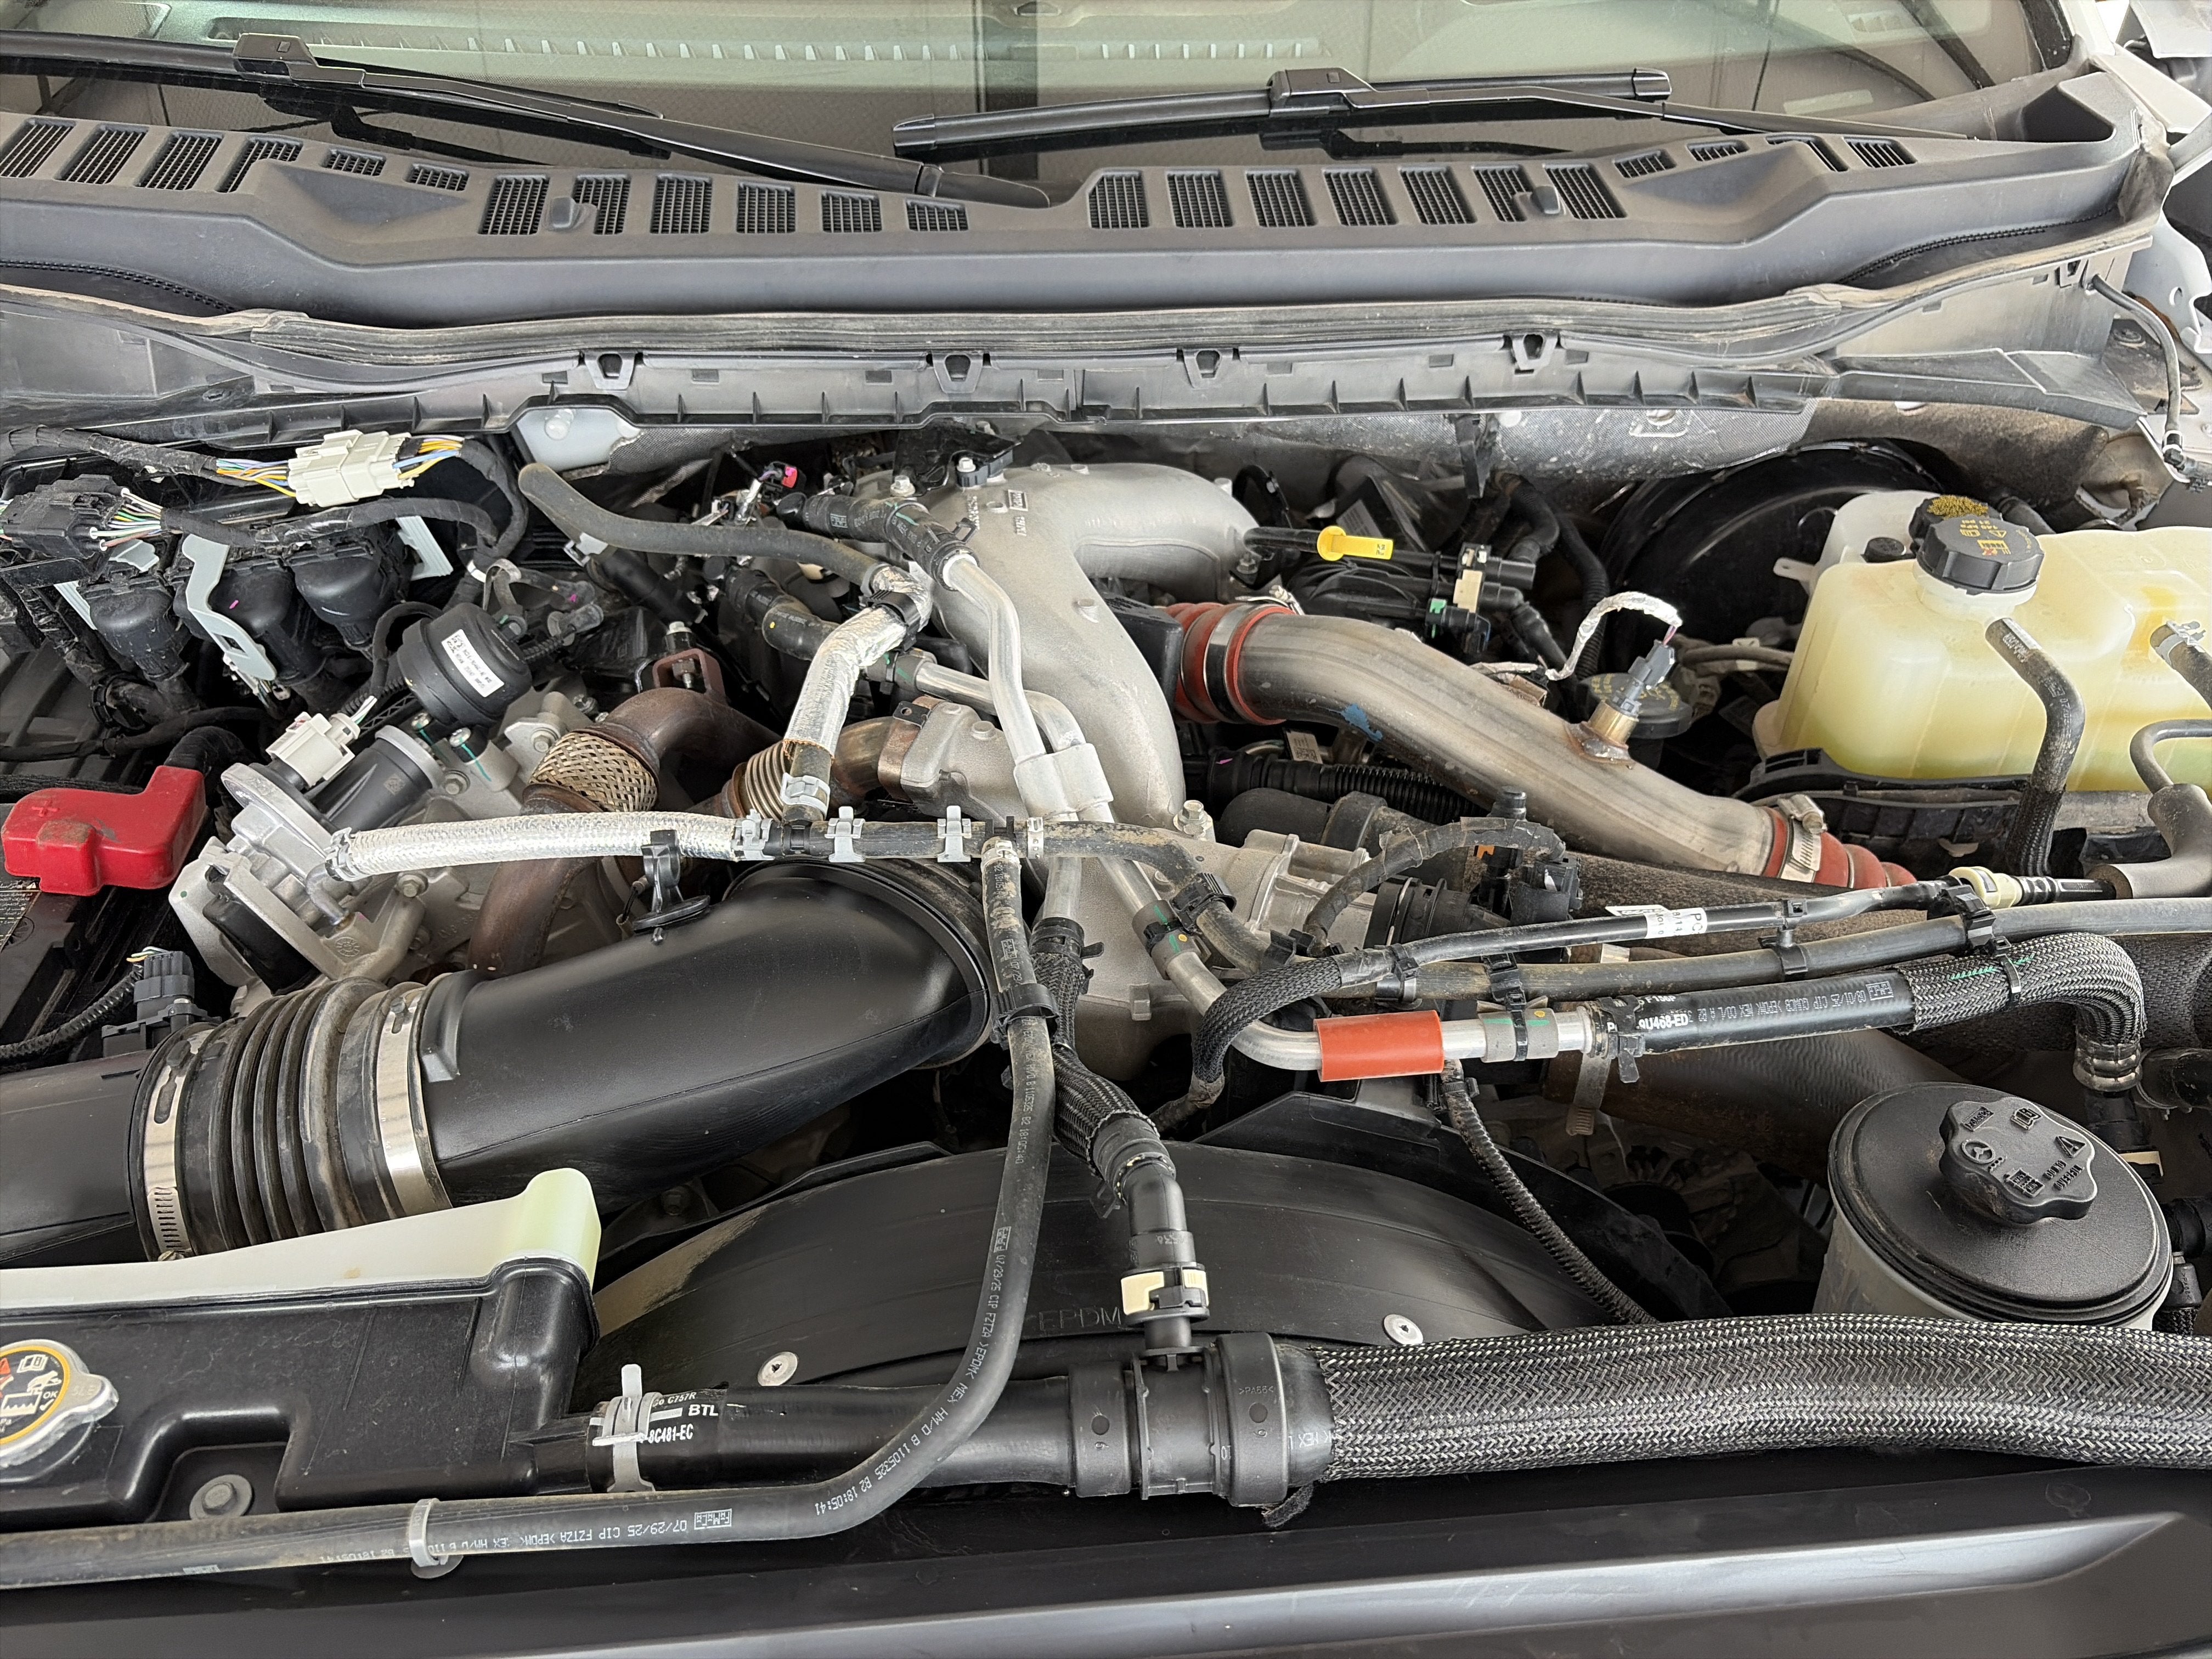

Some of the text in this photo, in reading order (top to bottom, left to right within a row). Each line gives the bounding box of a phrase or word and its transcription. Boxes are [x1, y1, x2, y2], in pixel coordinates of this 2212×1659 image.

[1011, 961, 1023, 984] 07/29/
[43, 1391, 58, 1400] OK
[688, 1403, 719, 1417] BTL
[921, 1407, 949, 1436] HM/D
[911, 1434, 921, 1446] B
[874, 1442, 911, 1480] 1105325
[859, 1476, 872, 1492] B2
[815, 1486, 858, 1516] 18:05:41
[599, 1526, 620, 1541] CIP
[628, 1519, 687, 1533] 07/29/25
[560, 1528, 592, 1543] FZTZA
